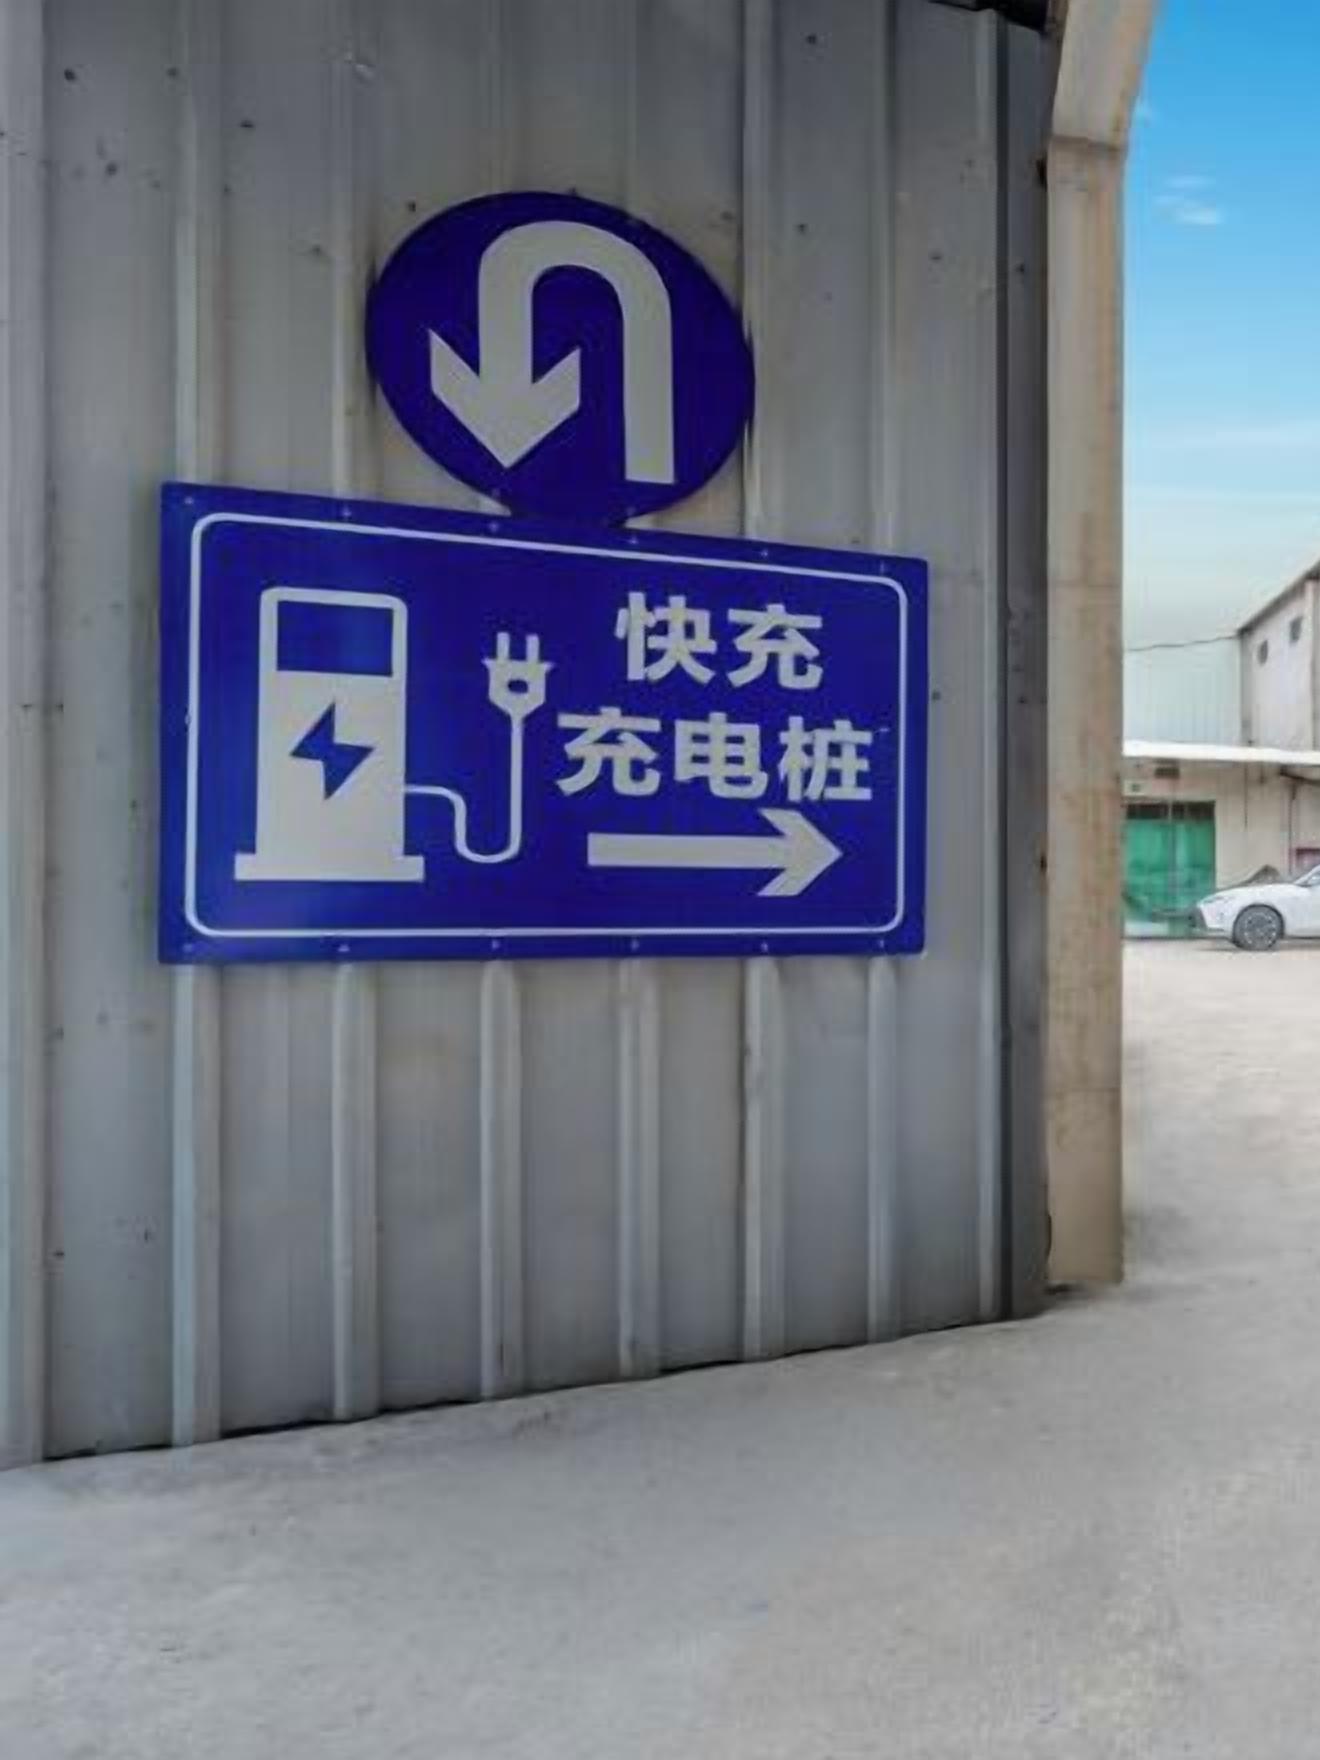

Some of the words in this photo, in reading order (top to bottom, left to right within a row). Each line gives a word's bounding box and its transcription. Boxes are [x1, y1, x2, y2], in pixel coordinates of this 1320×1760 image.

[615, 591, 823, 690] 快充
[556, 706, 873, 802] 充电桩
